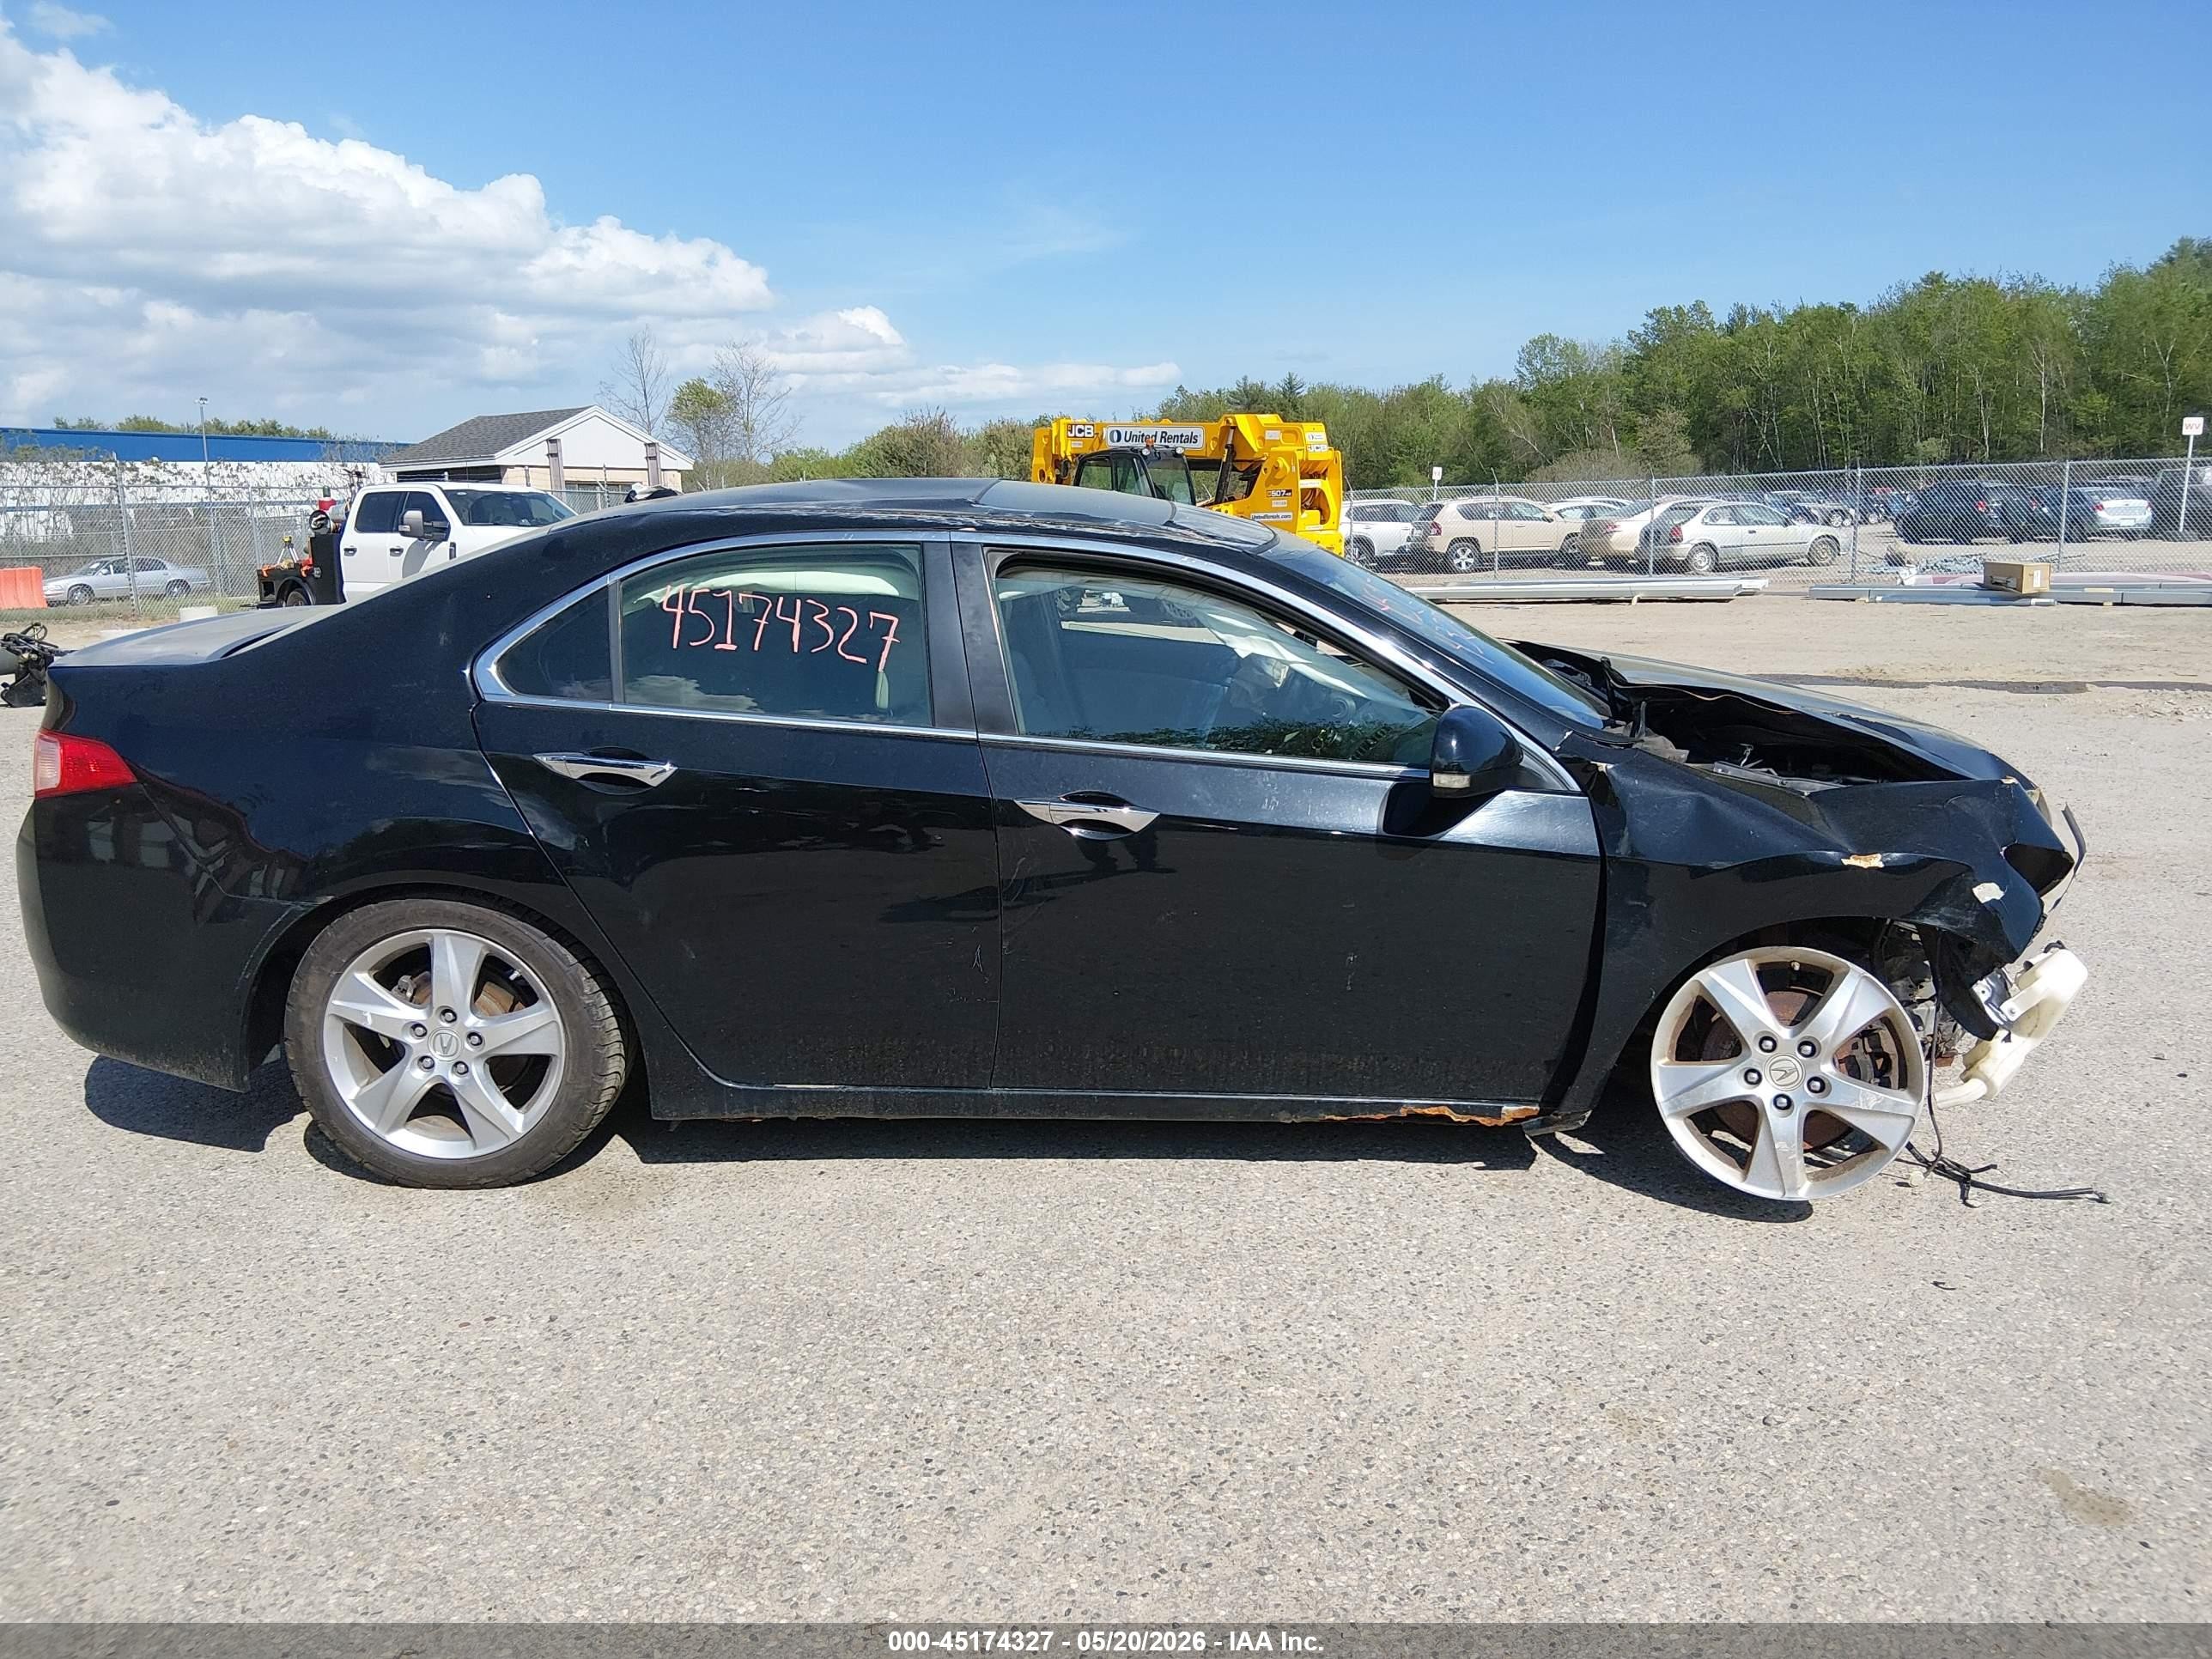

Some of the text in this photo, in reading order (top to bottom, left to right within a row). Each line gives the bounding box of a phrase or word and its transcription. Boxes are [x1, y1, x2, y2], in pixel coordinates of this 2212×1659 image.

[1067, 425, 1094, 437] JCB
[1124, 430, 1198, 444] United Rentals
[662, 585, 901, 673] 45174327
